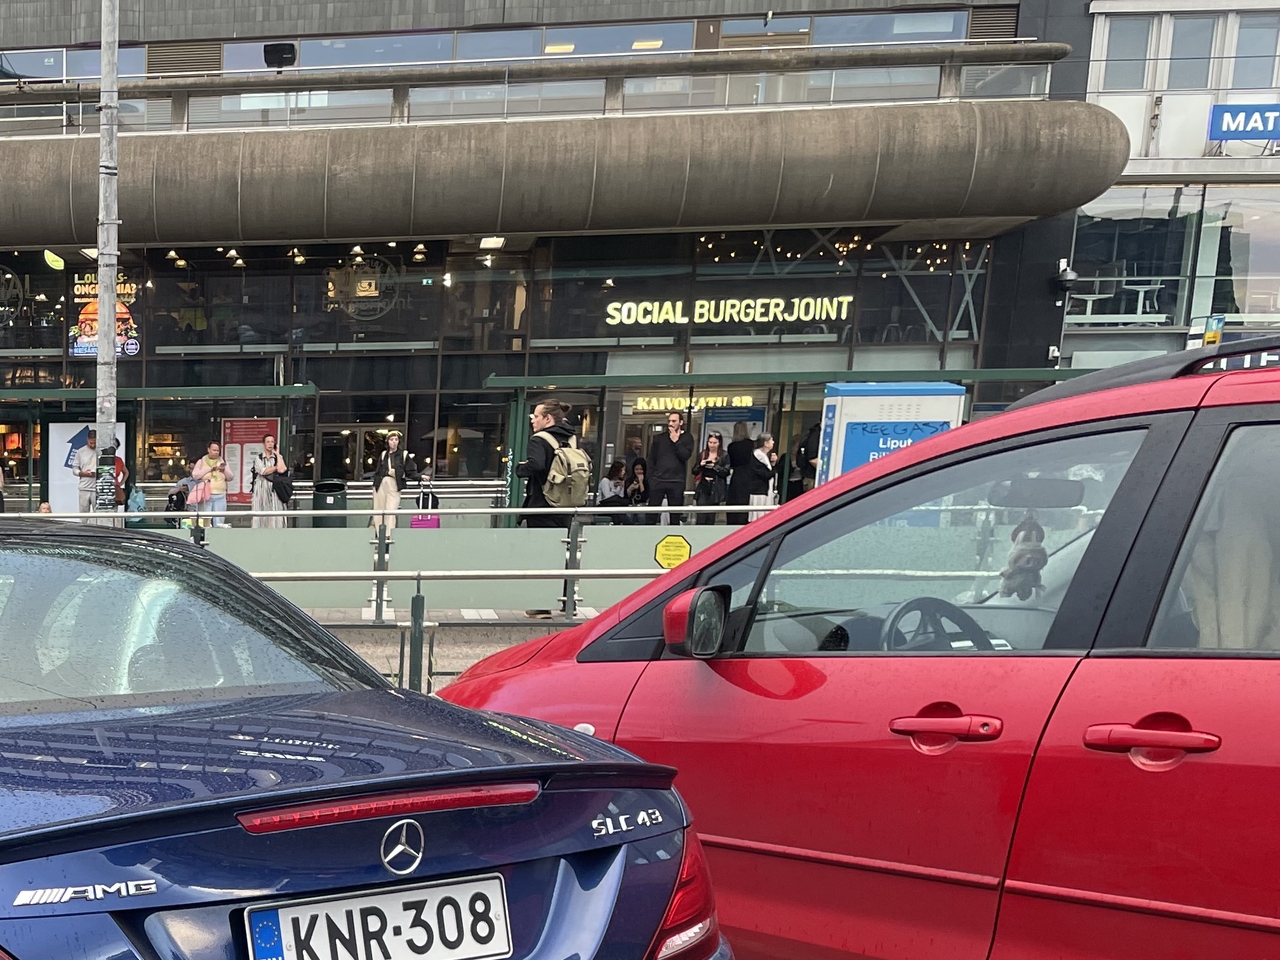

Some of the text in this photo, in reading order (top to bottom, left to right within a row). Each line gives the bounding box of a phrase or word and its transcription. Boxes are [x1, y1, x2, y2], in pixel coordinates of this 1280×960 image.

[606, 296, 853, 326] SOCIAL BURGERJOINT
[879, 437, 913, 450] Liput
[592, 808, 663, 837] SLC 43
[60, 879, 158, 904] AMG
